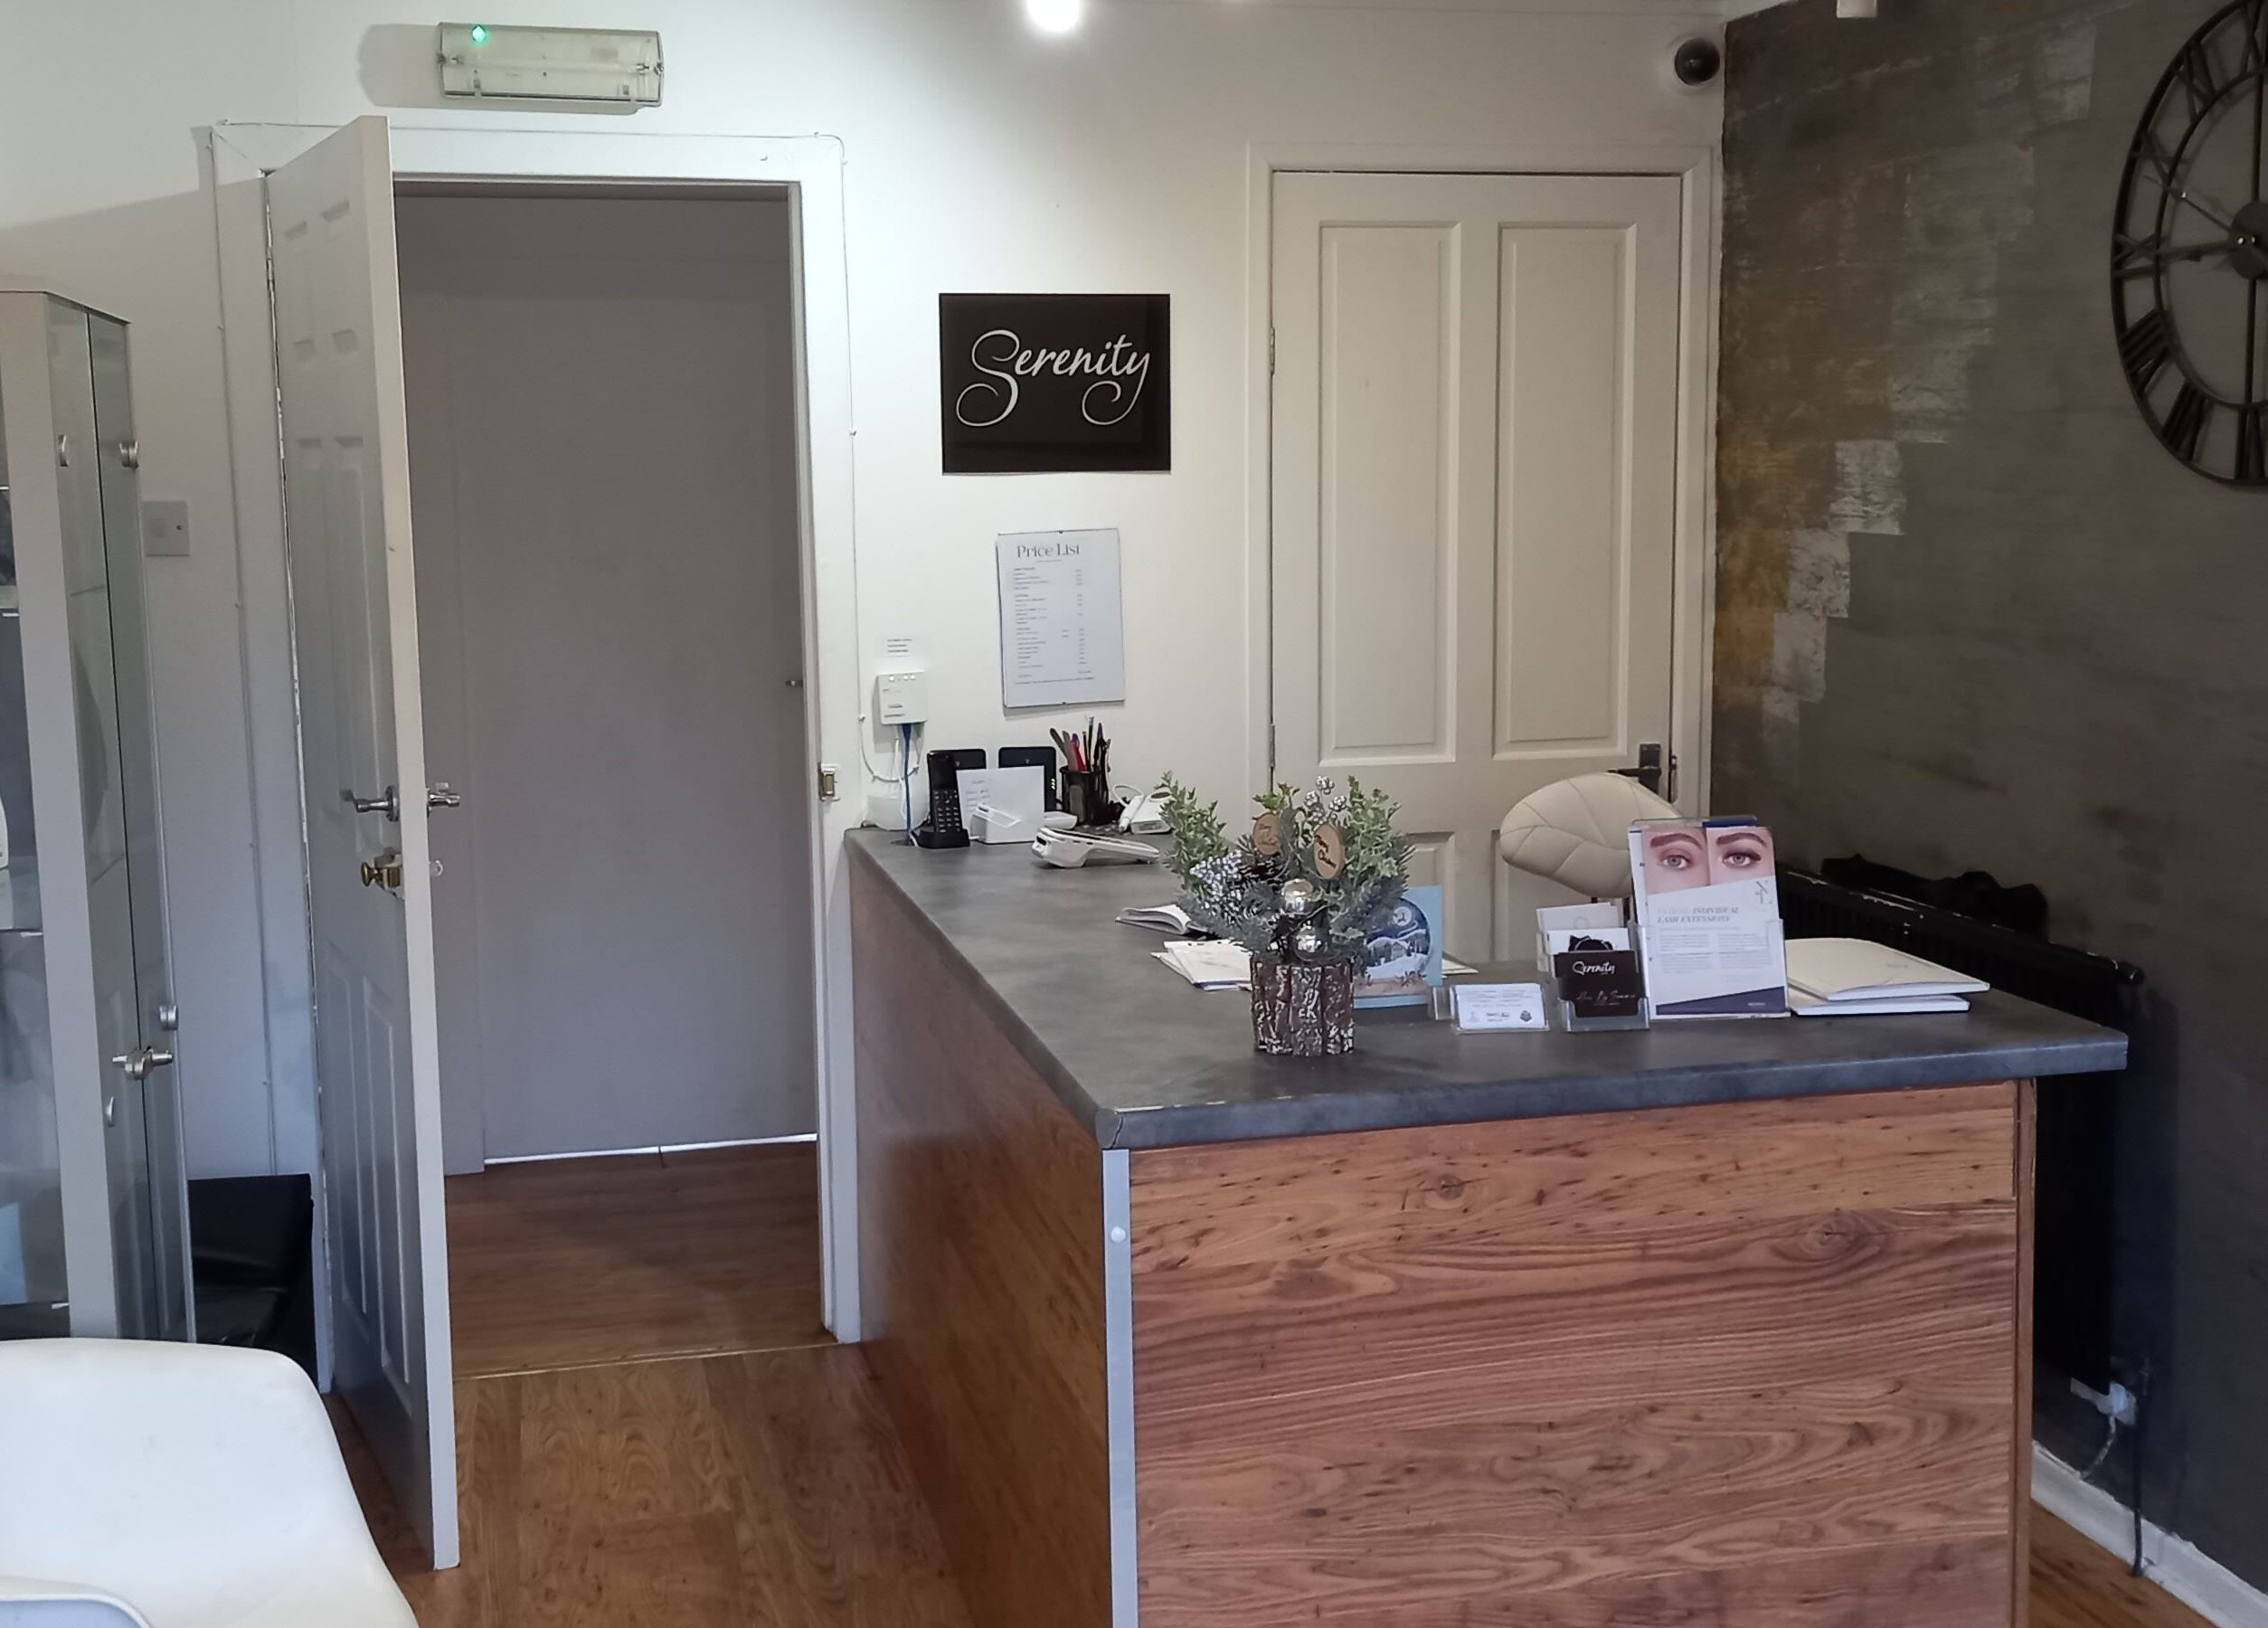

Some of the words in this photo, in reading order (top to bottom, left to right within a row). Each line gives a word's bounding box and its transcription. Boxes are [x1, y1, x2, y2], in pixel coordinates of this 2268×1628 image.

[956, 329, 1150, 427] Serenity
[1016, 544, 1054, 558] Price
[1057, 543, 1081, 555] List
[1573, 961, 1615, 975] Serenity
